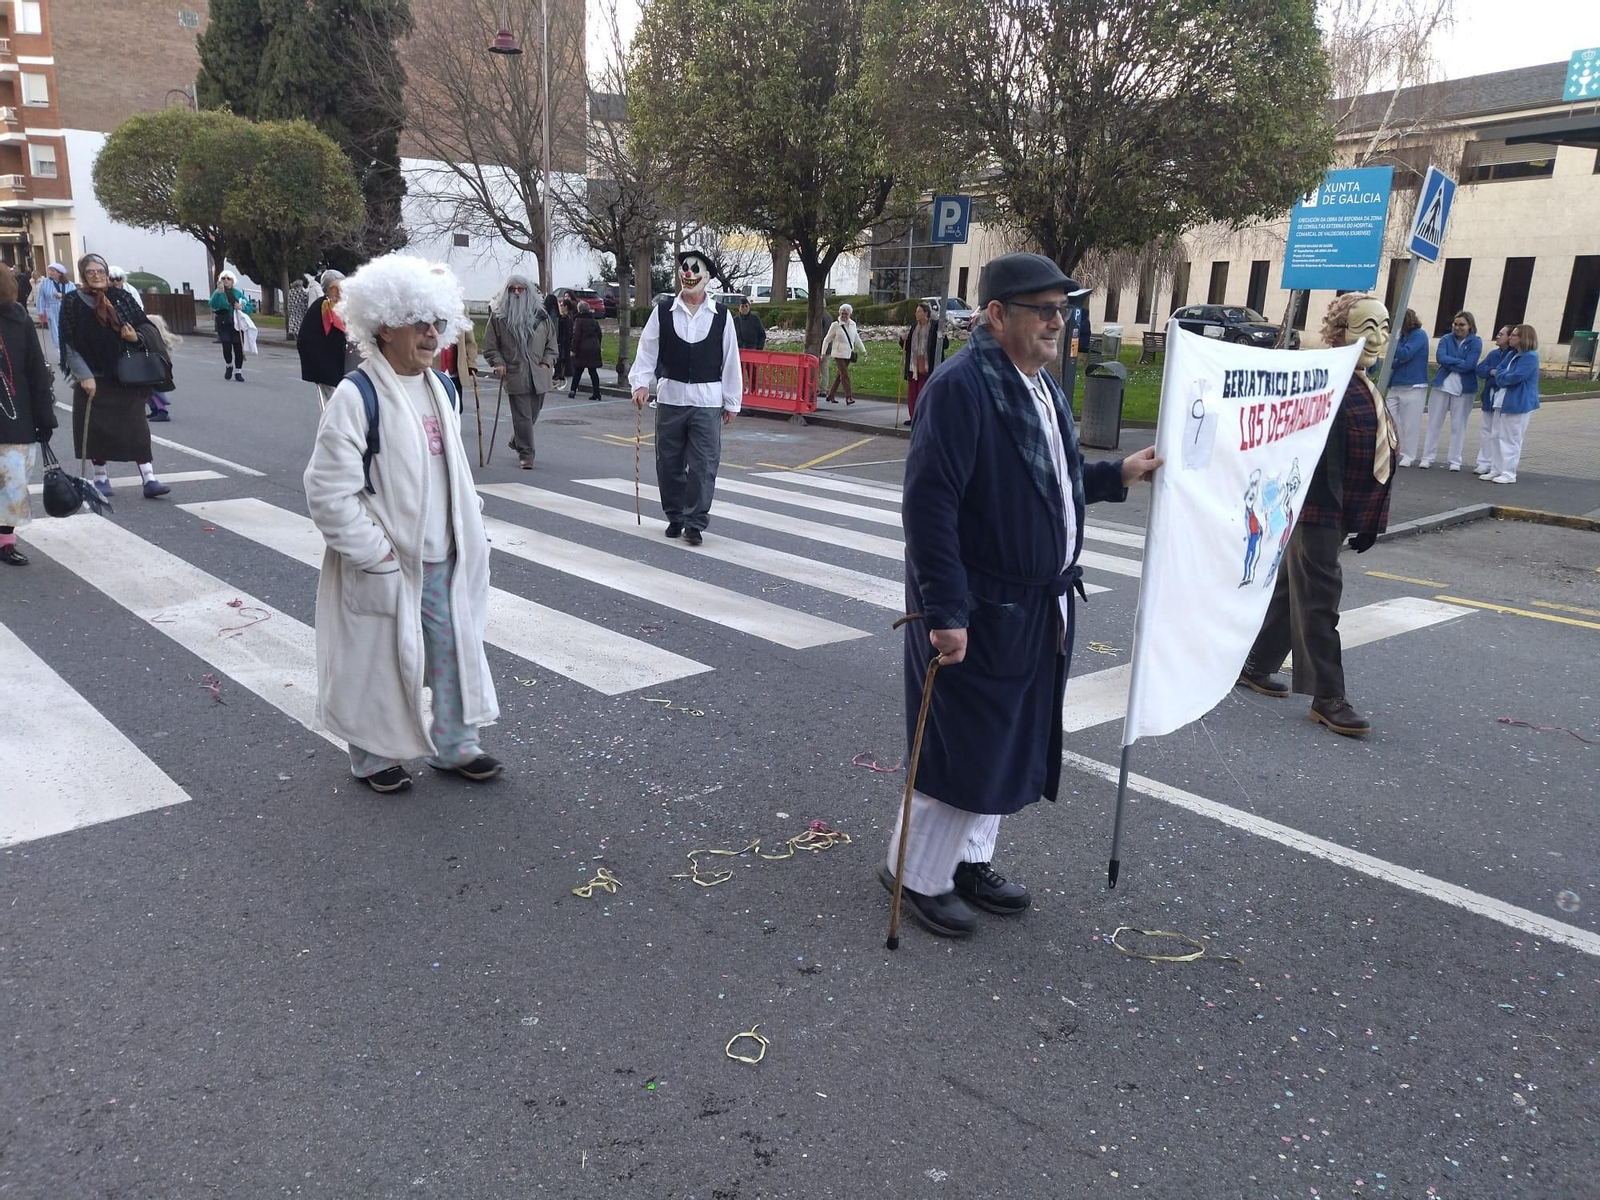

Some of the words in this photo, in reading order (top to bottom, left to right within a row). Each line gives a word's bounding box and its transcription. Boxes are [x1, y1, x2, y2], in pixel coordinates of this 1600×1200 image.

[1322, 195, 1336, 205] DE
[1338, 193, 1381, 205] GALICIA
[1324, 181, 1360, 193] XUNTA
[938, 201, 961, 237] P
[1075, 309, 1081, 320] P
[1222, 369, 1289, 398] GERIATRICO
[1290, 371, 1301, 396] EL
[1192, 398, 1205, 444] 9
[1240, 402, 1266, 451] LOS
